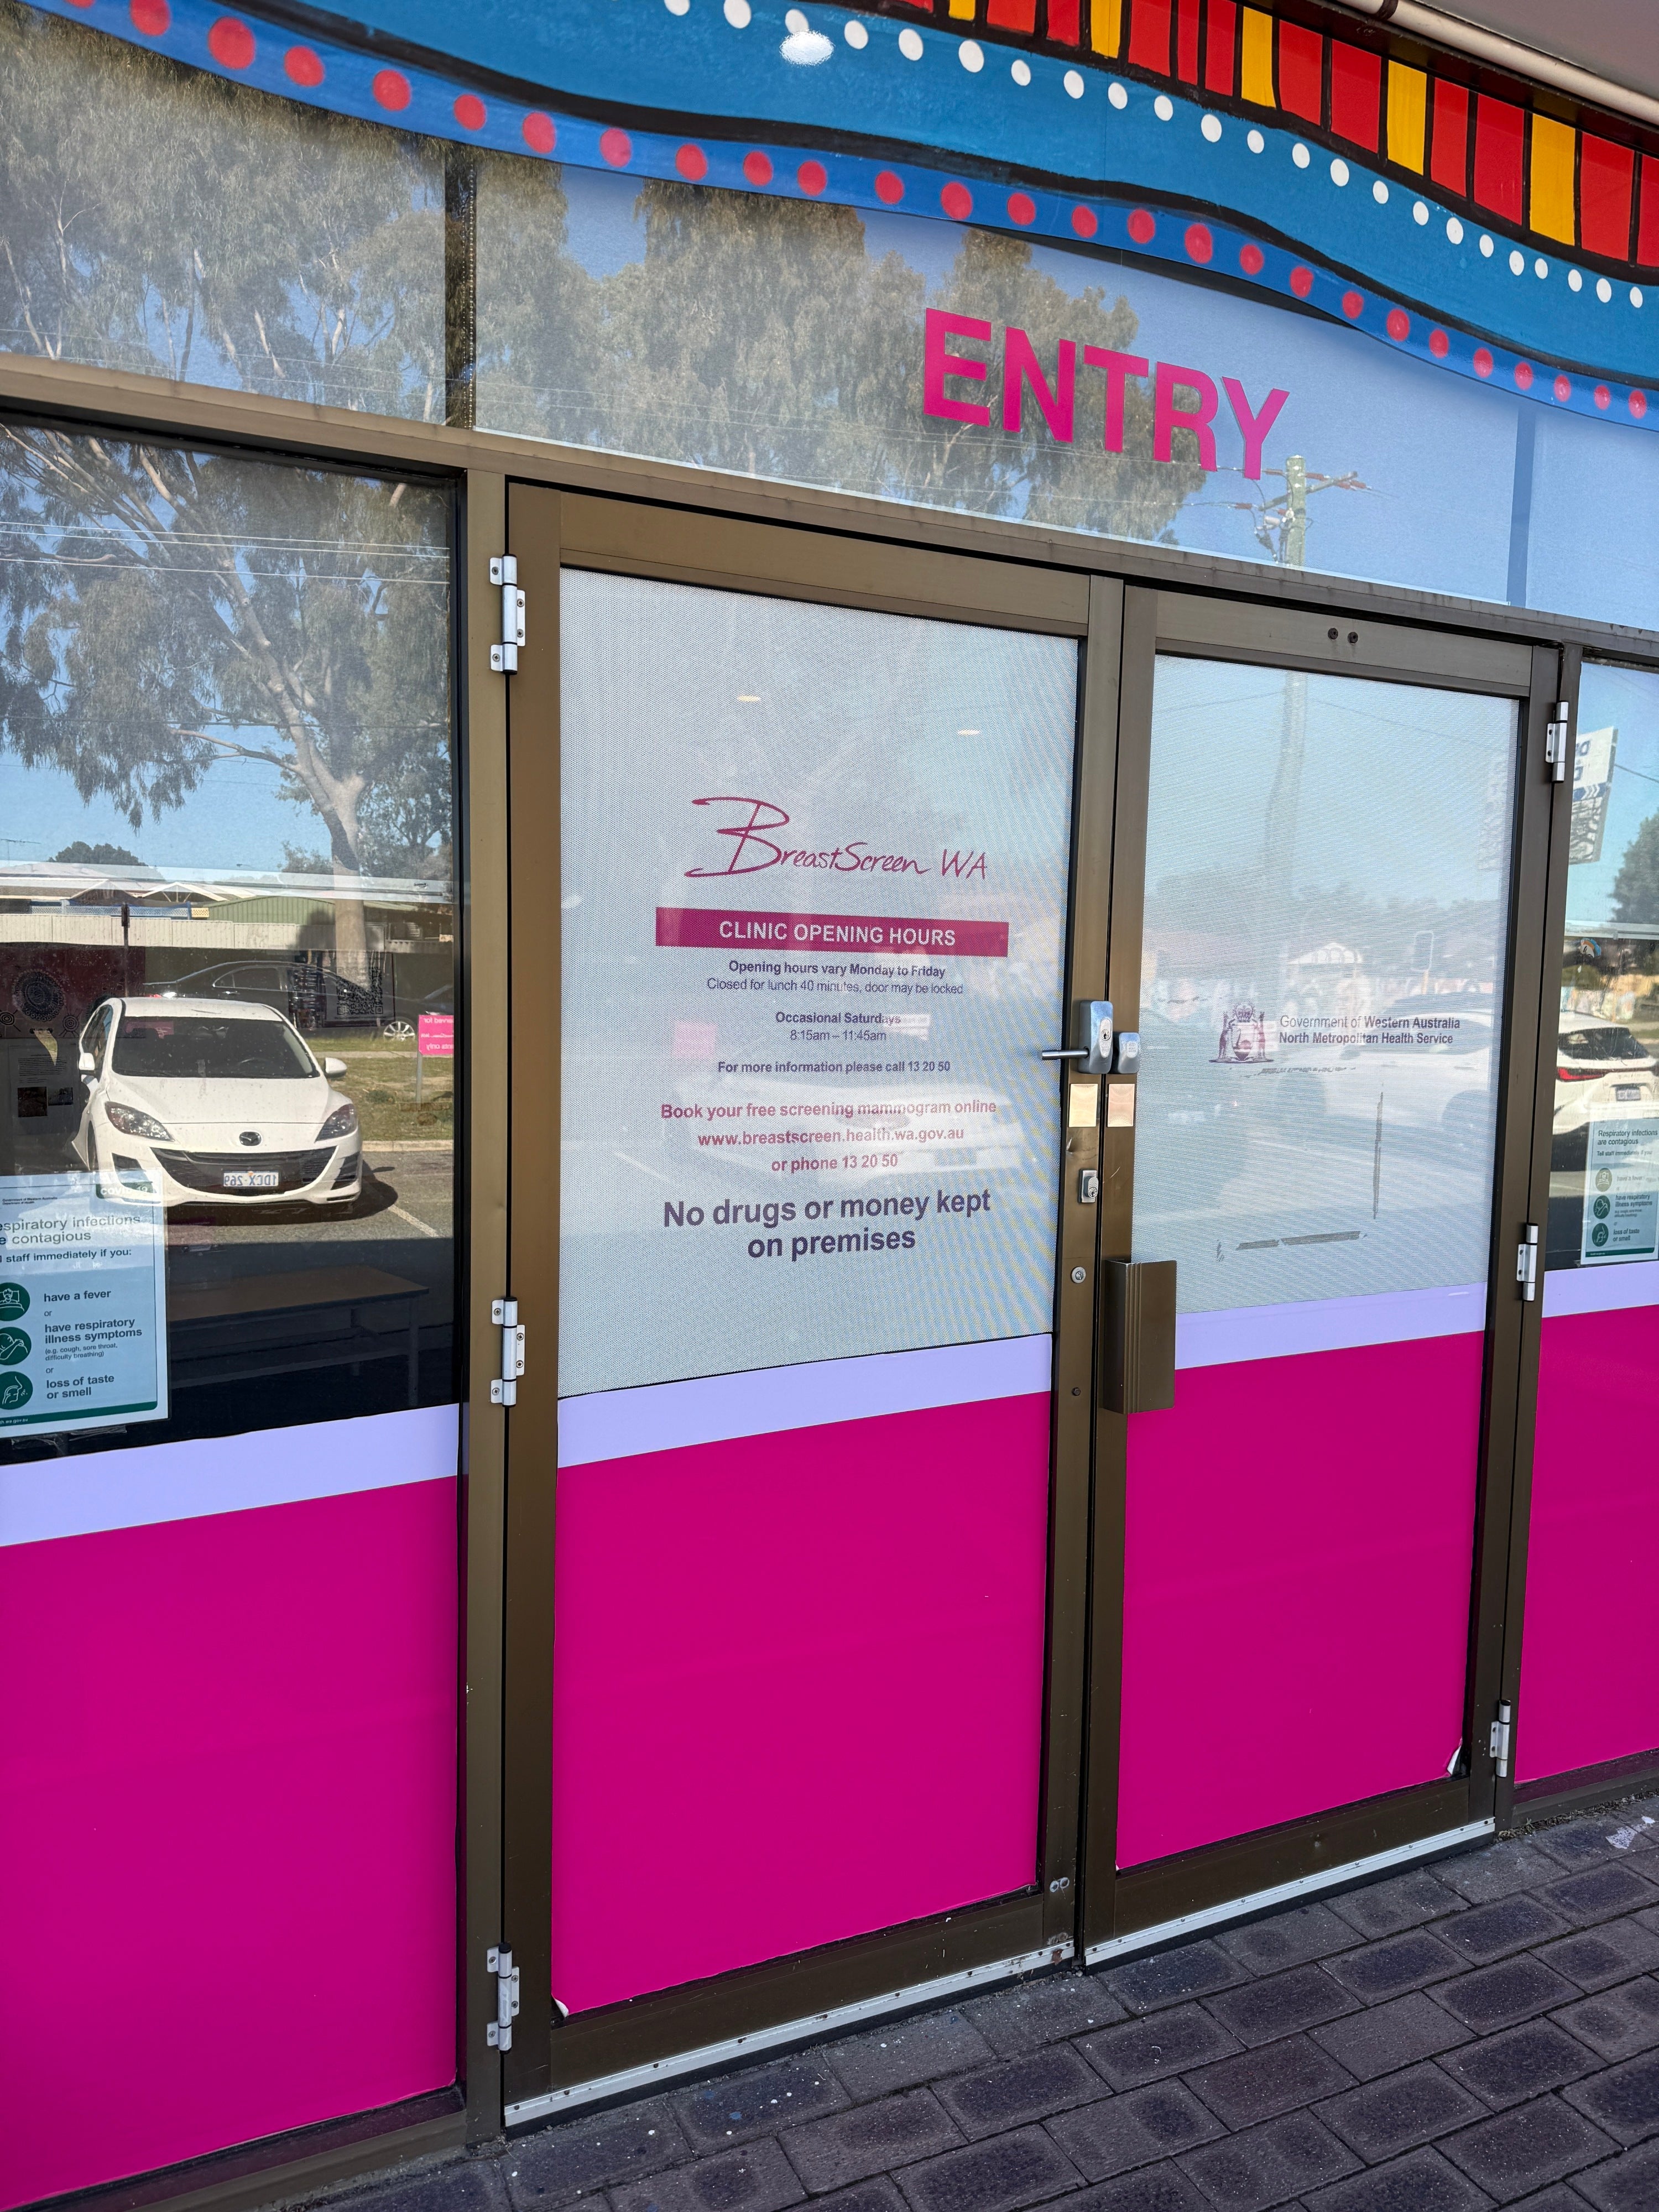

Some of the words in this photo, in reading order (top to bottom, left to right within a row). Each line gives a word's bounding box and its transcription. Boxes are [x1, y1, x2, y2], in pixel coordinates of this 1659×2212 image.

[924, 307, 1290, 480] ENTRY
[684, 796, 932, 878] BreastScreen
[941, 848, 987, 879] WA
[719, 920, 788, 940] CLINIC
[794, 923, 884, 944] OPENING
[889, 928, 956, 946] HOURS
[728, 960, 781, 976] Opening
[784, 961, 818, 974] hours
[821, 964, 847, 977] vary
[850, 964, 895, 978] Monday
[897, 966, 909, 976] to
[911, 966, 946, 979] Friday
[707, 978, 748, 990] Closed
[750, 978, 765, 990] for
[768, 979, 798, 990] lunch
[800, 980, 814, 990] 40
[816, 980, 862, 994] minutes,
[864, 982, 889, 994] door
[891, 984, 912, 996] may
[915, 983, 929, 994] be
[931, 984, 963, 995] locked
[775, 1011, 841, 1024] Occasional
[843, 1013, 901, 1025] Saturdays
[1280, 1015, 1348, 1029] Government
[1350, 1016, 1362, 1028] of
[1364, 1016, 1410, 1029] Western
[1412, 1017, 1460, 1029] Australia
[790, 1030, 830, 1041] 8:15am
[844, 1030, 887, 1041] 11:45am
[1279, 1031, 1309, 1044] North
[1312, 1031, 1379, 1045] Metropolitan
[1381, 1032, 1414, 1045] Health
[1416, 1032, 1453, 1045] Service
[718, 1061, 739, 1073] For
[741, 1063, 771, 1072] more
[774, 1061, 843, 1072] information
[845, 1061, 883, 1074] please
[885, 1061, 905, 1072] call
[907, 1061, 920, 1072] 13
[922, 1061, 936, 1072] 20
[937, 1061, 951, 1072] 50
[661, 1103, 703, 1119] Book
[707, 1105, 743, 1121] your
[746, 1103, 775, 1117] free
[779, 1102, 854, 1118] screening
[857, 1102, 952, 1117] mammogram
[954, 1099, 997, 1114] online
[698, 1127, 964, 1146] www.breastscreen.health.wa.gov.au
[1598, 1129, 1630, 1138] Respiratory
[771, 1161, 787, 1171] or
[790, 1156, 838, 1173] phone
[843, 1155, 858, 1169] 13
[861, 1154, 878, 1168] 20
[881, 1152, 899, 1167] 50
[664, 1201, 705, 1227] No
[713, 1198, 796, 1228] drugs
[805, 1200, 834, 1221] or
[841, 1194, 929, 1221] money
[936, 1189, 991, 1217] kept
[72, 1215, 140, 1227] infections
[12, 1232, 91, 1244] contagious
[748, 1238, 782, 1258] on
[791, 1227, 916, 1262] premises
[6, 1253, 30, 1262] staff
[34, 1249, 97, 1261] immediately
[100, 1249, 107, 1257] if
[110, 1249, 132, 1258] you:
[44, 1293, 70, 1302] have
[84, 1290, 112, 1299] fever
[45, 1324, 71, 1333] have
[75, 1319, 135, 1331] respiratory
[45, 1334, 81, 1344] illness
[85, 1329, 142, 1342] symptoms
[73, 1350, 104, 1359] breathing)
[46, 1380, 70, 1389] loss
[72, 1376, 84, 1386] of
[87, 1374, 114, 1385] taste
[46, 1391, 59, 1400] or
[62, 1387, 92, 1398] smell
